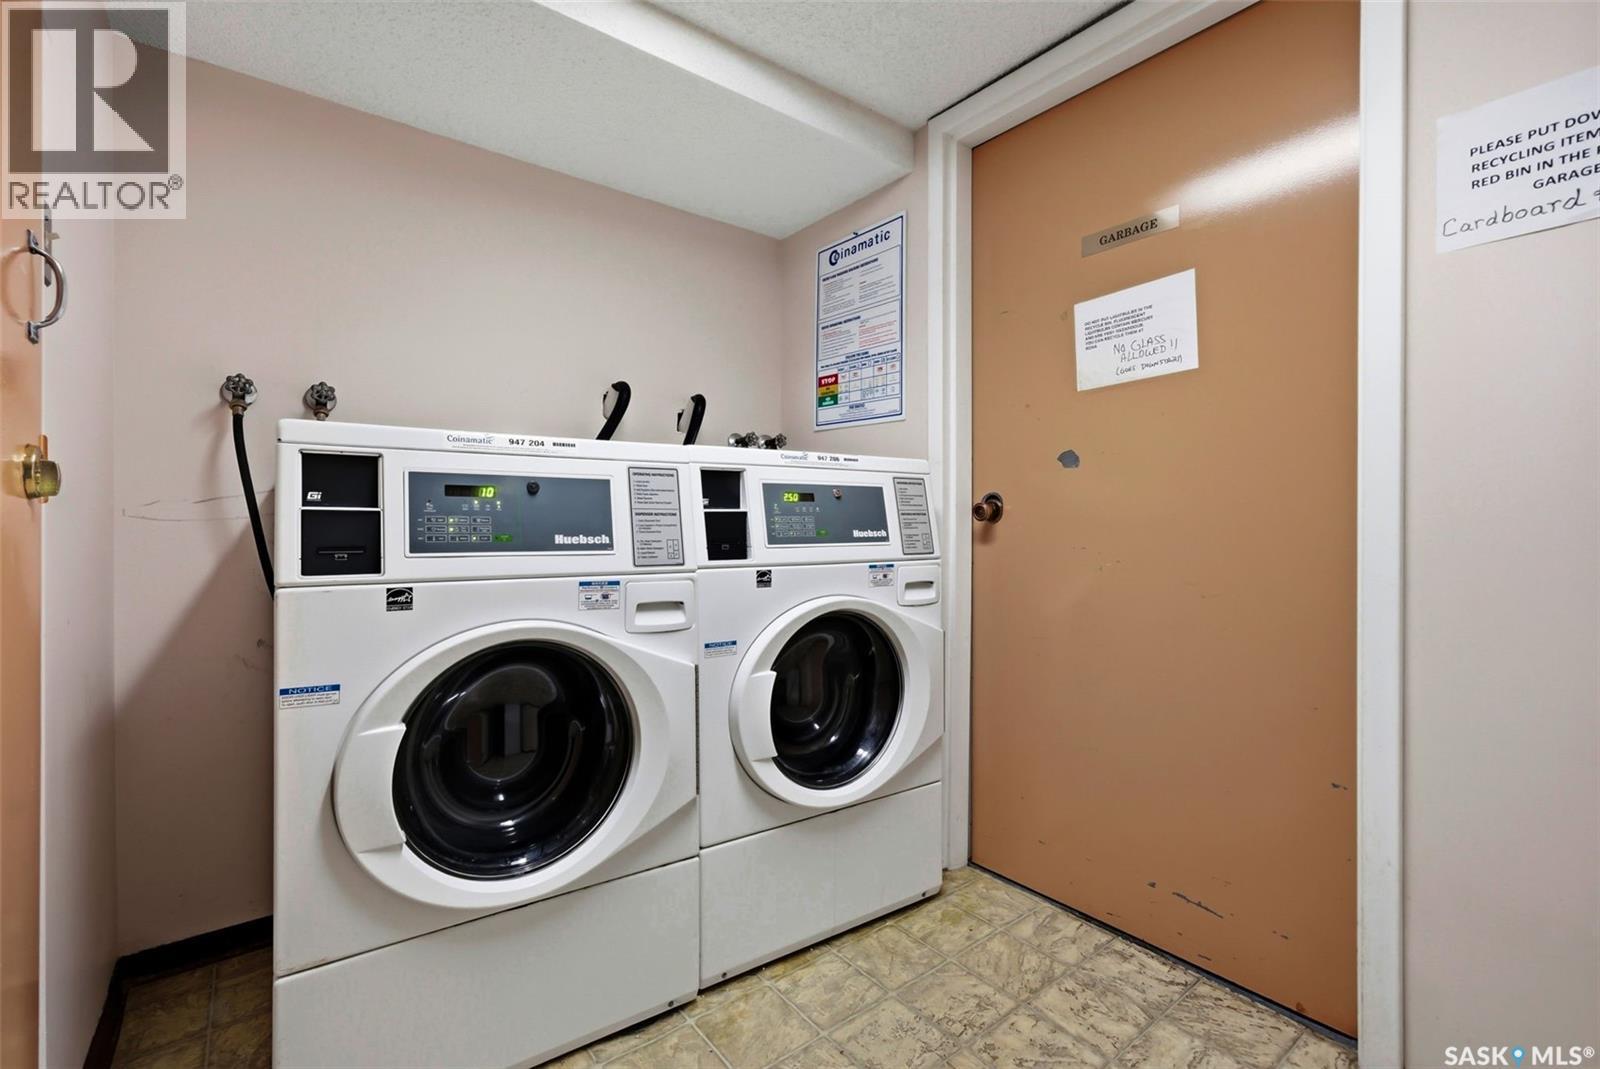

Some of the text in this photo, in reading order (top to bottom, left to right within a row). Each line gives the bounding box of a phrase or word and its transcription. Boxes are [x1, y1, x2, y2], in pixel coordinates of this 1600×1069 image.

[1469, 133, 1523, 158] PLEASE
[1527, 121, 1561, 141] PUT
[1471, 141, 1556, 173] RECYCLING
[1471, 174, 1501, 190] RED
[1505, 165, 1532, 181] BIN
[1536, 158, 1554, 172] IN
[1559, 148, 1591, 166] THE
[1532, 162, 1600, 190] GARAGE
[1442, 188, 1587, 237] Cardboard
[1099, 218, 1159, 246] GARBAGE
[1131, 315, 1153, 324] MERCURY
[1113, 335, 1166, 355] NO GLASS
[1120, 345, 1167, 363] ALLOWED
[821, 376, 836, 385] STOP
[446, 434, 495, 445] Coinamatic
[508, 438, 525, 446] 947
[528, 439, 545, 447] 204
[306, 491, 322, 500] Gi
[480, 486, 495, 498] 10
[554, 534, 611, 545] Huebsch
[852, 529, 888, 539] Huebsch
[288, 685, 333, 695] NOTICE
